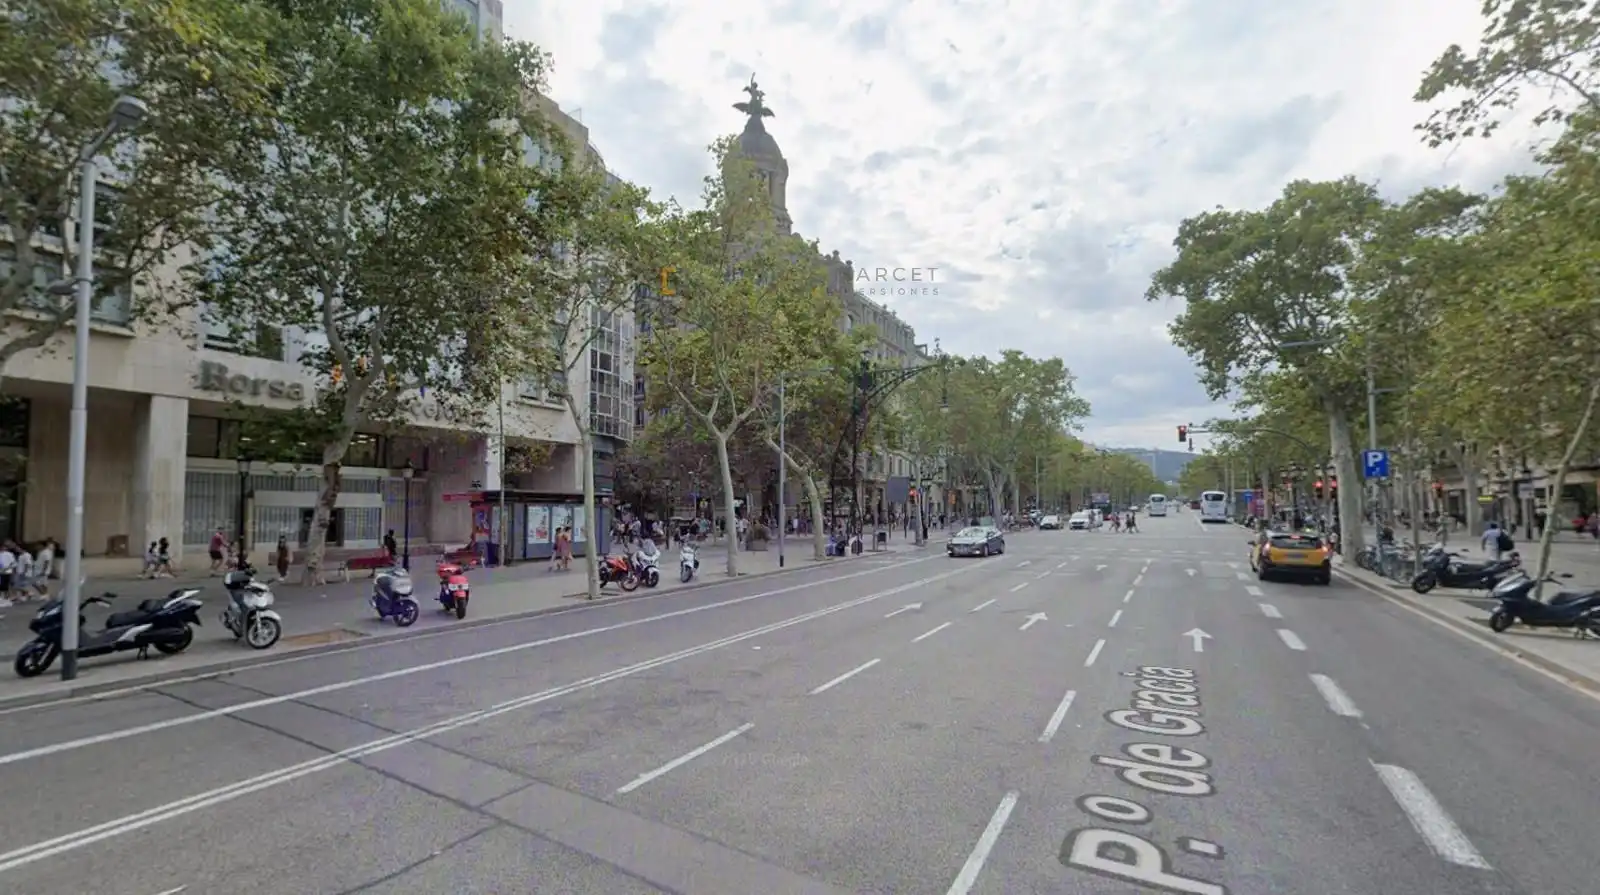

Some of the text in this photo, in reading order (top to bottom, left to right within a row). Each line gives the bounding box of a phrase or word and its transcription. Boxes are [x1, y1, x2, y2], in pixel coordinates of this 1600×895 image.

[198, 359, 305, 401] Borsa
[1367, 452, 1383, 467] P
[1107, 665, 1205, 735] Gracia
[1094, 742, 1213, 796] de
